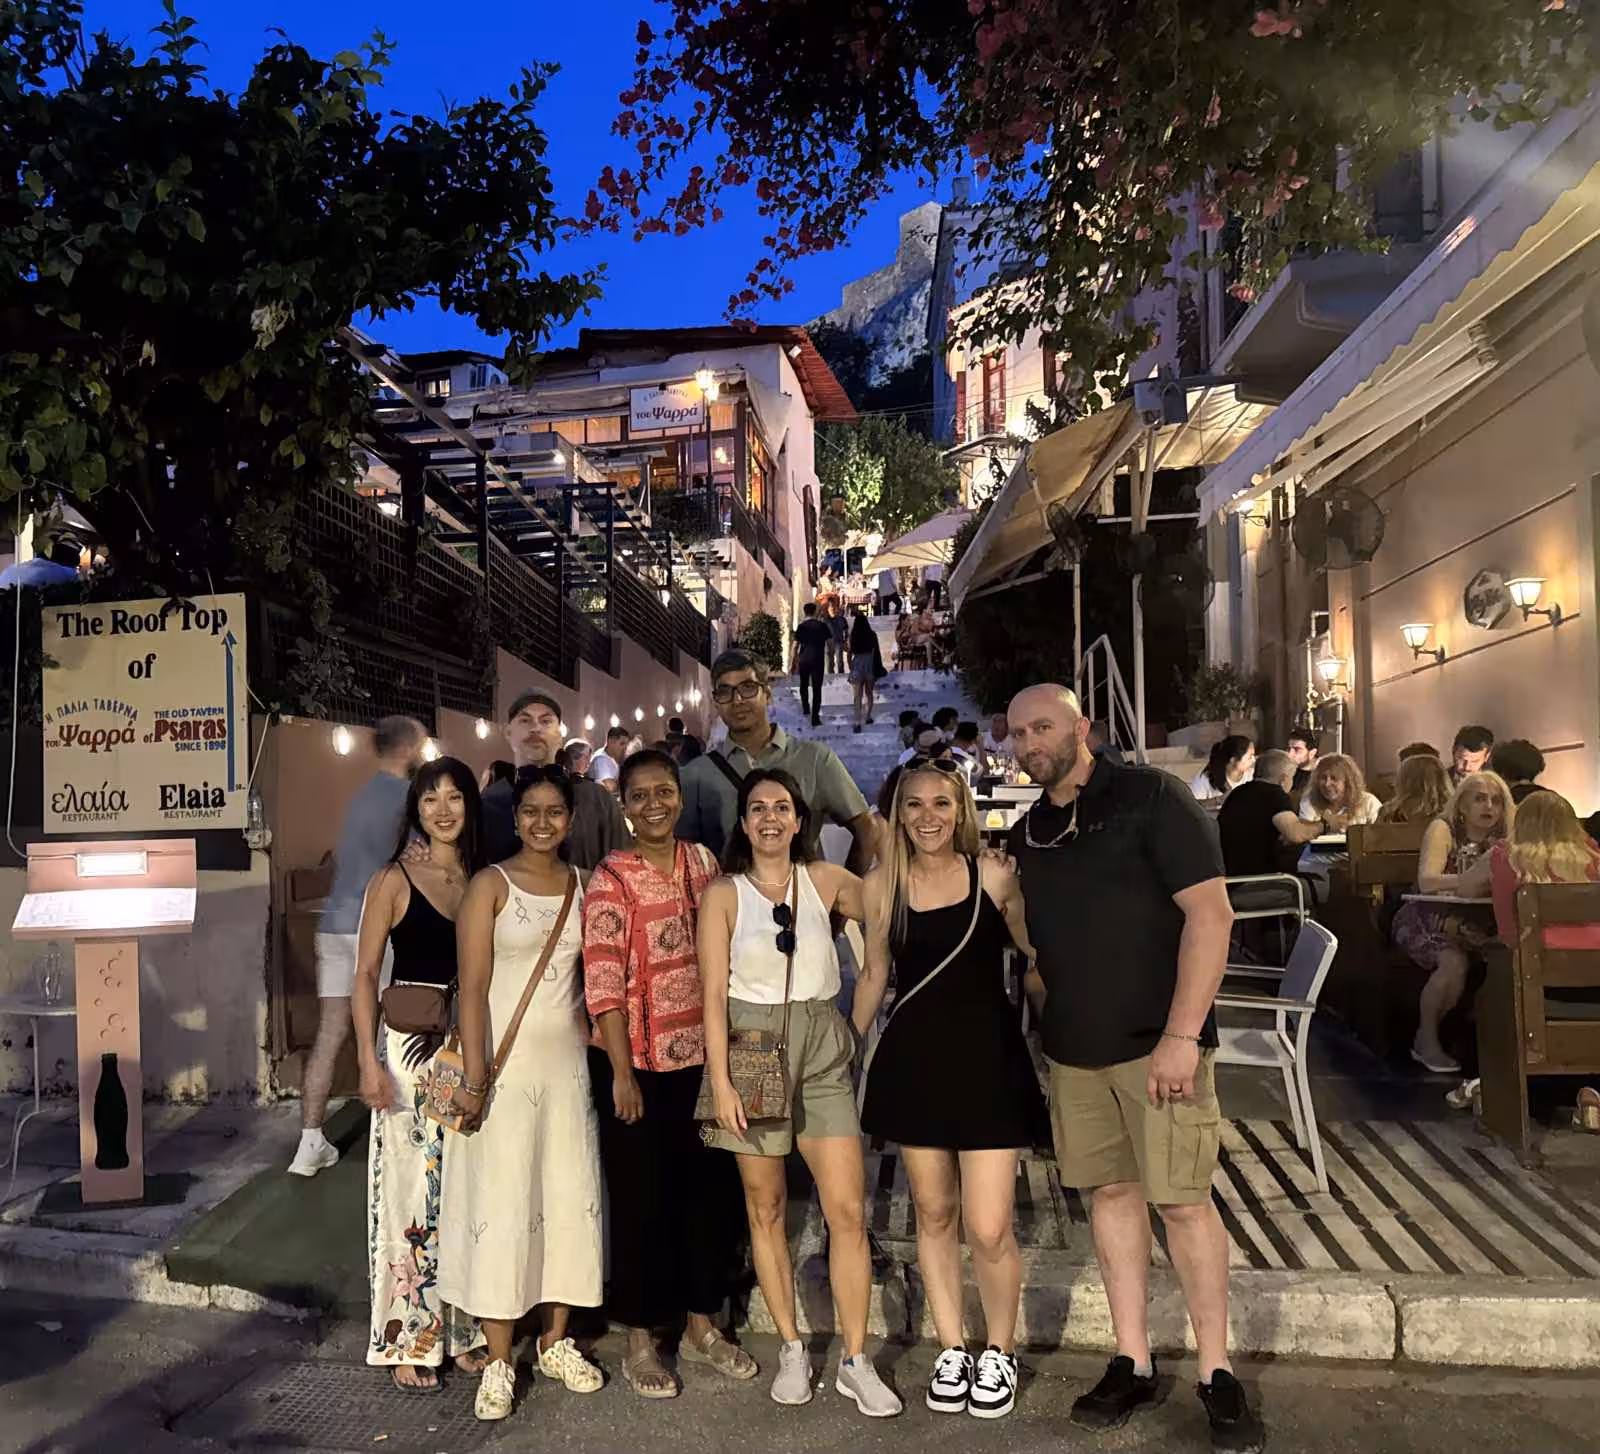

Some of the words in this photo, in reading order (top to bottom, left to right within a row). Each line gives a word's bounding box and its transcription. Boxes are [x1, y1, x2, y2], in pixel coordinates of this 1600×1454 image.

[652, 402, 698, 422] Ψαρρά
[57, 612, 103, 638] The
[110, 608, 170, 635] Roof
[176, 605, 228, 635] Top
[128, 653, 157, 679] of
[56, 701, 89, 719] ΠΑΛΙΑ
[93, 698, 138, 721] ΤΑΒΕΡΝΑ
[154, 711, 170, 719] THE
[171, 709, 189, 718] OLD
[190, 707, 225, 717] TAVERN
[45, 740, 60, 748] του
[59, 720, 136, 753] Ψαρρά
[143, 733, 153, 743] of
[154, 719, 227, 742] Psaras
[175, 742, 201, 752] SINCE
[51, 781, 130, 813] ελαία
[159, 781, 227, 811] Elaia
[62, 812, 119, 822] RESTAURANT
[163, 809, 223, 819] RESTAURANT
